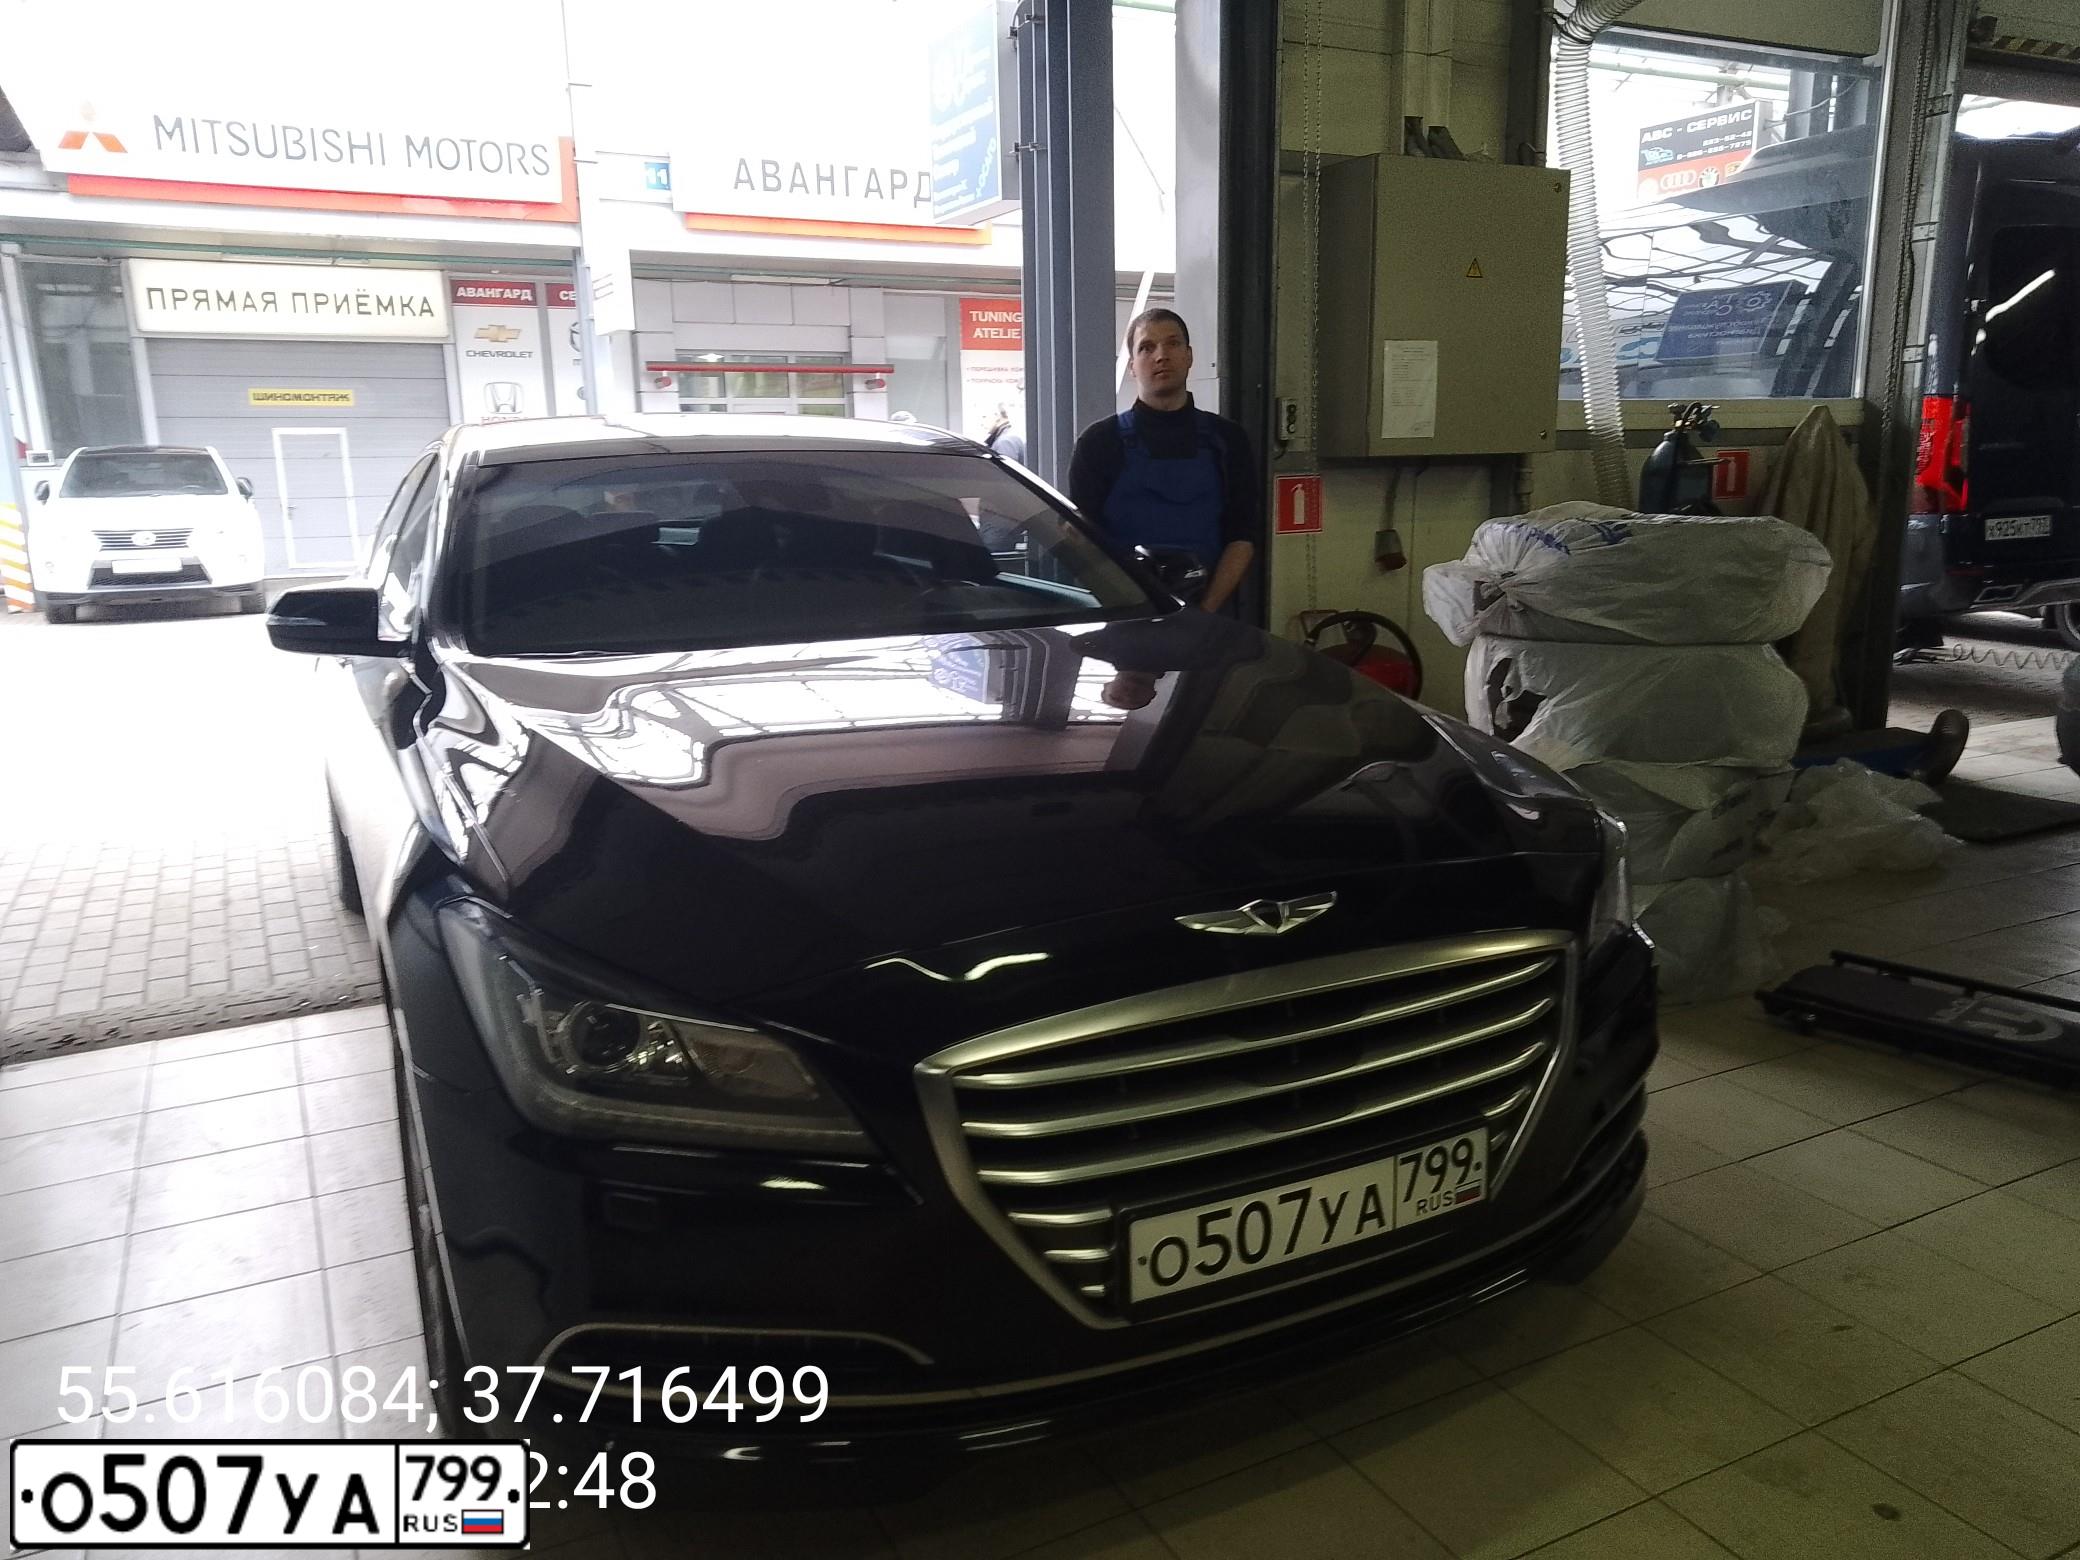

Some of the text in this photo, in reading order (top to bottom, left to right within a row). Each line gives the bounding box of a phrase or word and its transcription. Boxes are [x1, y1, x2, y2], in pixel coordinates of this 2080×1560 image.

[1686, 109, 1753, 133] СЕРВИС
[154, 115, 550, 176] MITSUBISHI MOTORS
[733, 158, 931, 208] АВАНГАРД
[147, 287, 435, 318] ПРЯМАЯ ПРИЁМКА
[456, 287, 533, 301] АВАНГАРД
[969, 310, 1024, 323] TUNING
[465, 350, 534, 359] CHEVROLET
[252, 392, 350, 402] ШИНОМОНТАЖ
[1400, 1137, 1476, 1203] 799
[1416, 1190, 1455, 1217] RUS
